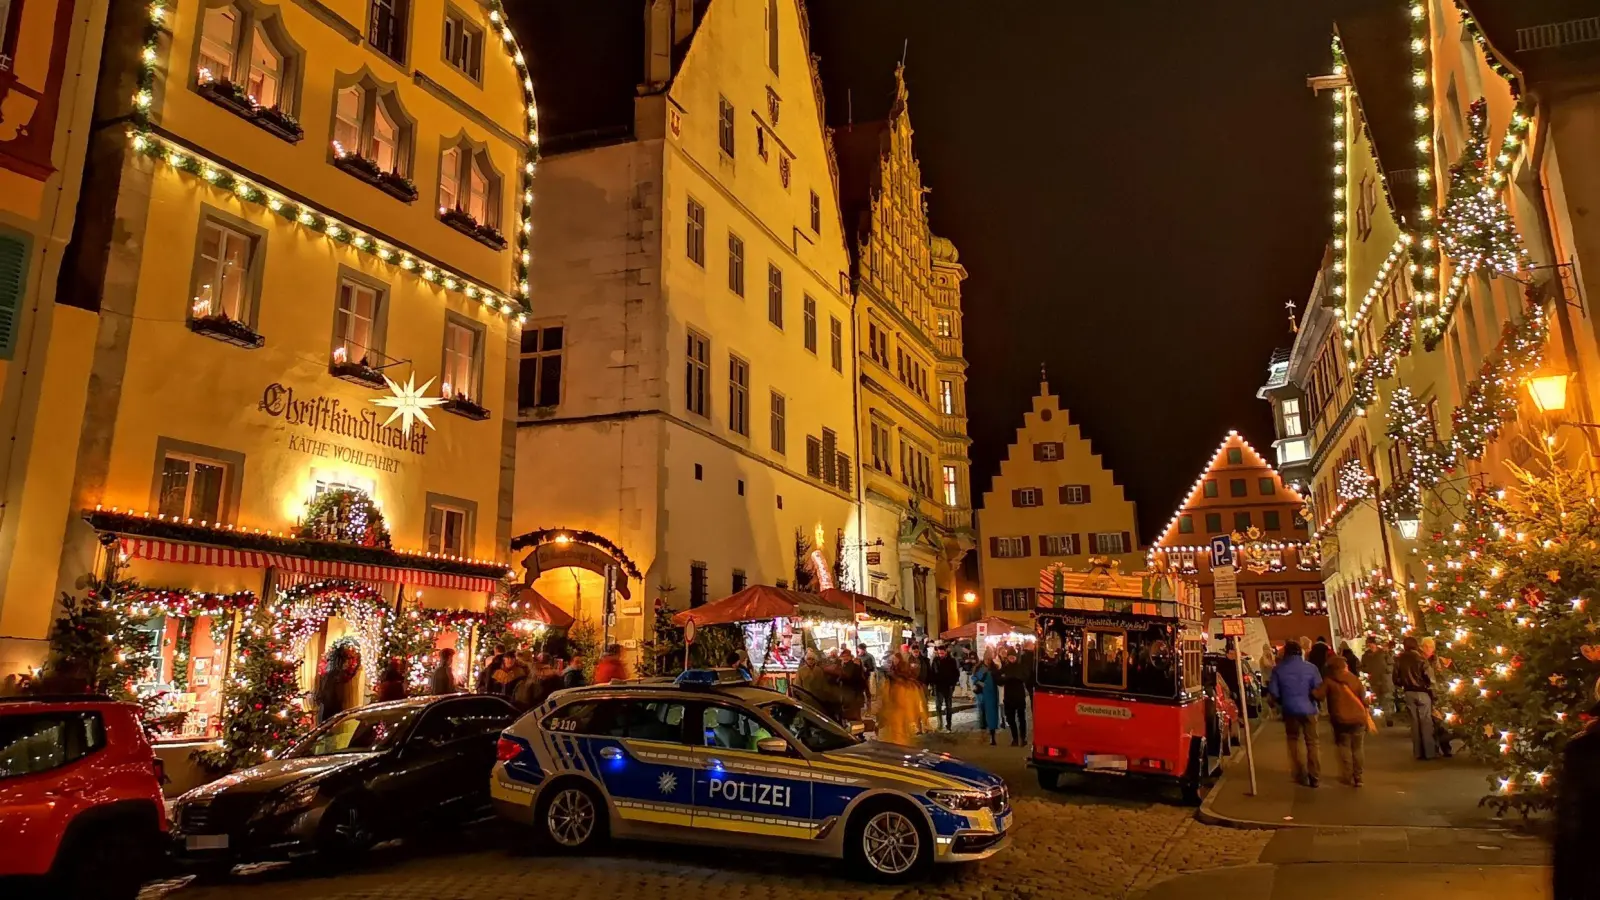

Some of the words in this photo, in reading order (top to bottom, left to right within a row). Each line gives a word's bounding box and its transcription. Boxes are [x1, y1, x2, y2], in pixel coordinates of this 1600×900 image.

[334, 444, 400, 473] WOHLFAHRT
[1213, 540, 1225, 565] P
[560, 719, 577, 731] 110
[709, 778, 791, 807] POLIZEI
